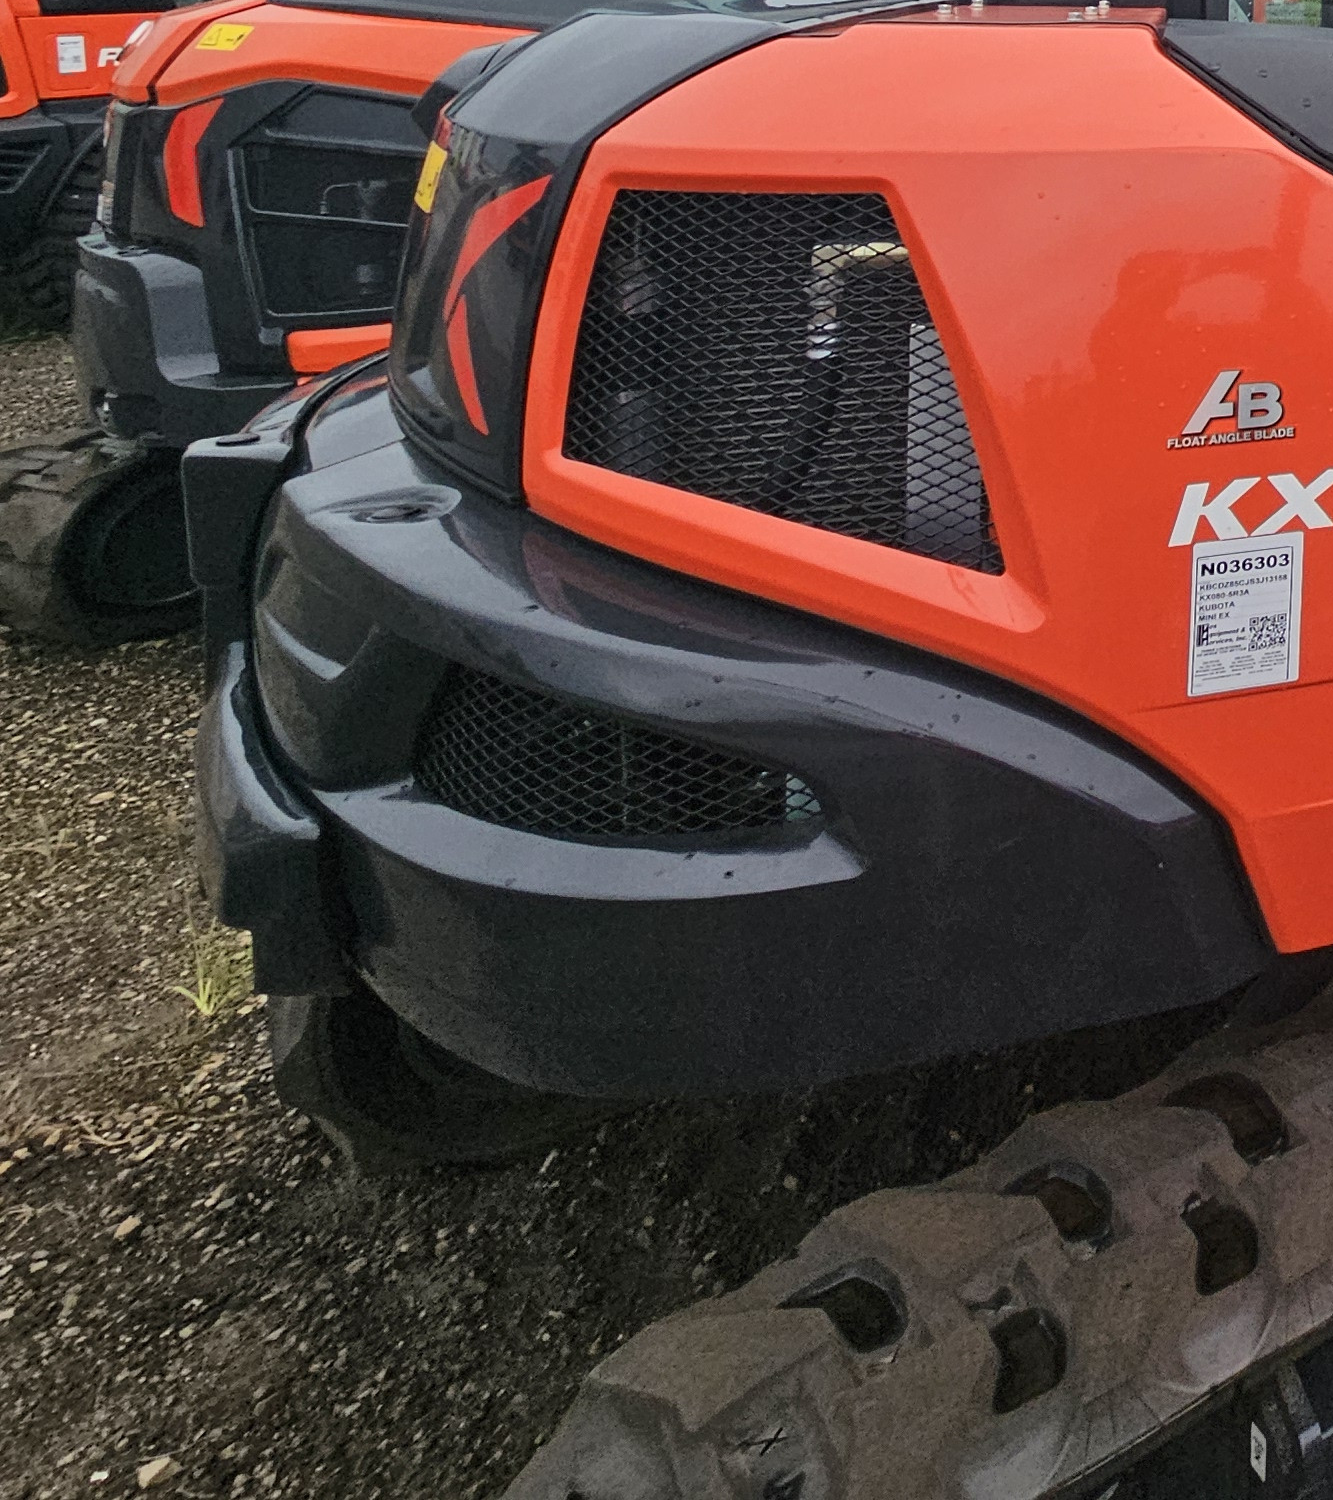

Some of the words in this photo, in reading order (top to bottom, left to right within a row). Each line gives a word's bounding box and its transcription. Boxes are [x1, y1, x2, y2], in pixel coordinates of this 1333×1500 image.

[1166, 435, 1207, 450] FLOAT
[1208, 430, 1252, 445] ANGLE
[1253, 426, 1295, 441] BLADE
[1200, 553, 1290, 577] N036303
[1198, 601, 1236, 613] KUBOTA
[1218, 611, 1231, 620] EX
